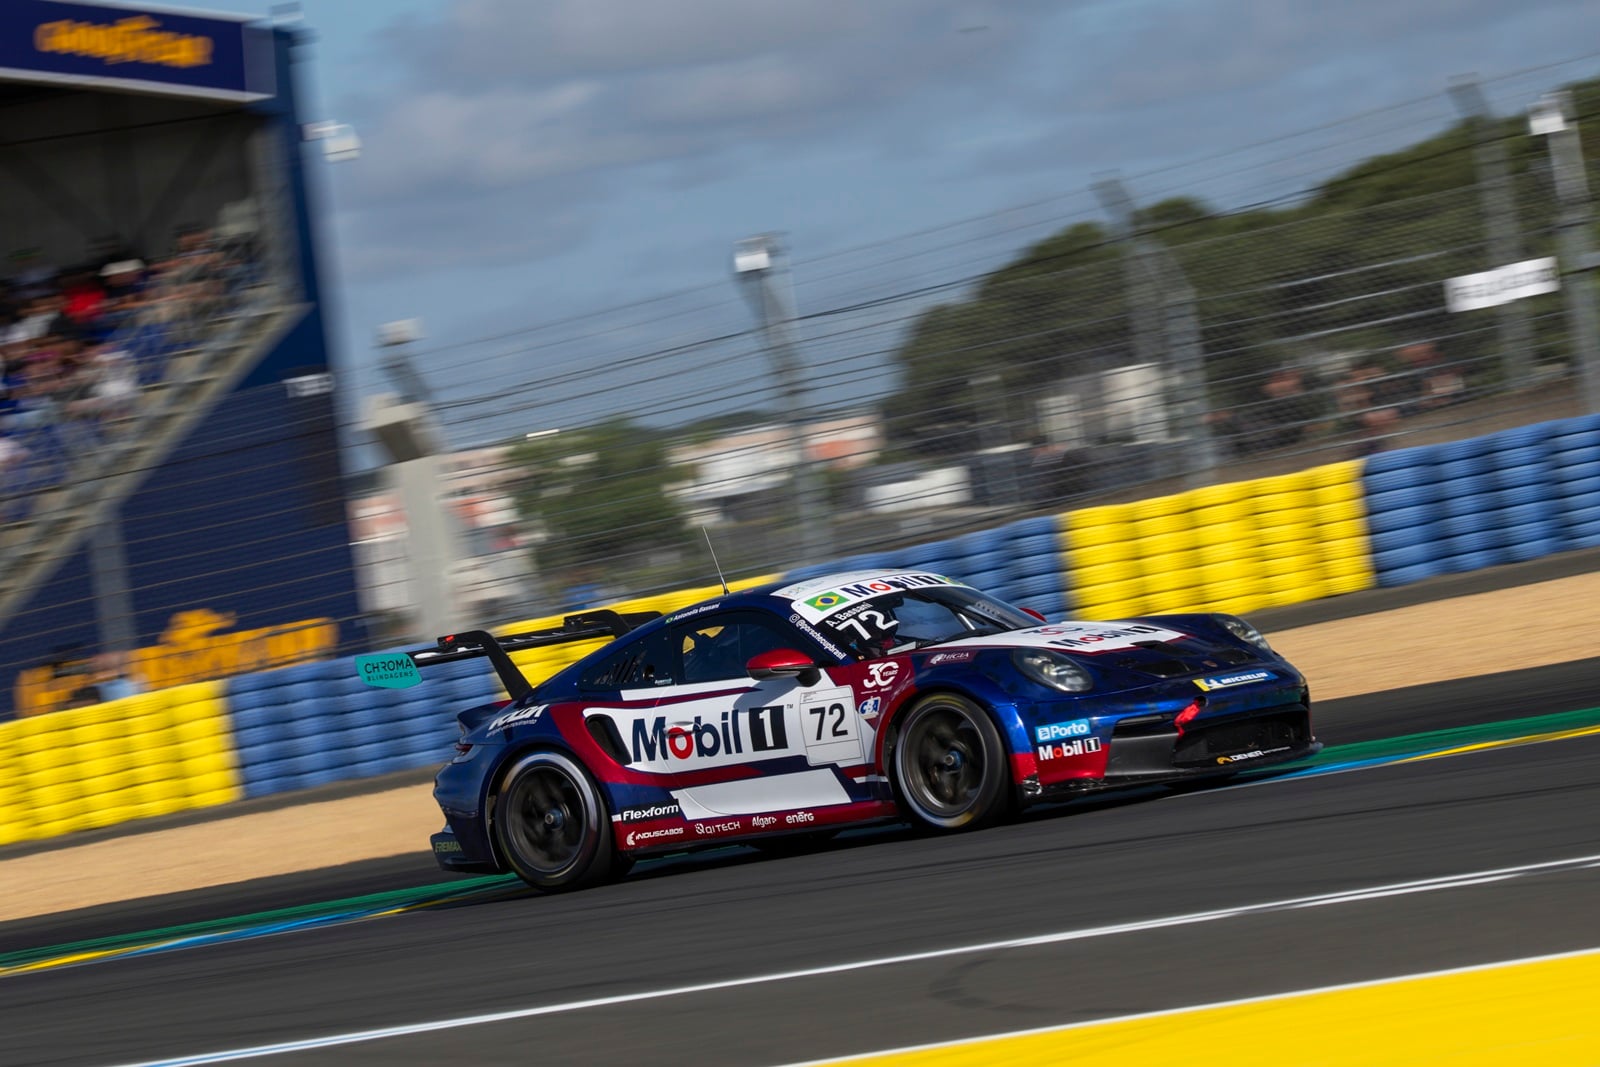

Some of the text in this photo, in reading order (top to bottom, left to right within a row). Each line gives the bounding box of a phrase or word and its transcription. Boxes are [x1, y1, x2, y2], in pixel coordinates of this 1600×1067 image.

[840, 576, 918, 598] Mobil
[825, 601, 873, 627] A. Bassani
[835, 610, 900, 640] 72
[364, 658, 413, 674] CHROMA
[367, 670, 414, 682] BLINDAGENS
[1221, 672, 1268, 684] MICHELIN
[809, 703, 848, 741] 72
[1050, 723, 1087, 738] Porto
[632, 709, 743, 762] Mobil
[1038, 740, 1083, 761] Mobil
[623, 804, 679, 821] Flexform
[752, 816, 772, 828] Algar
